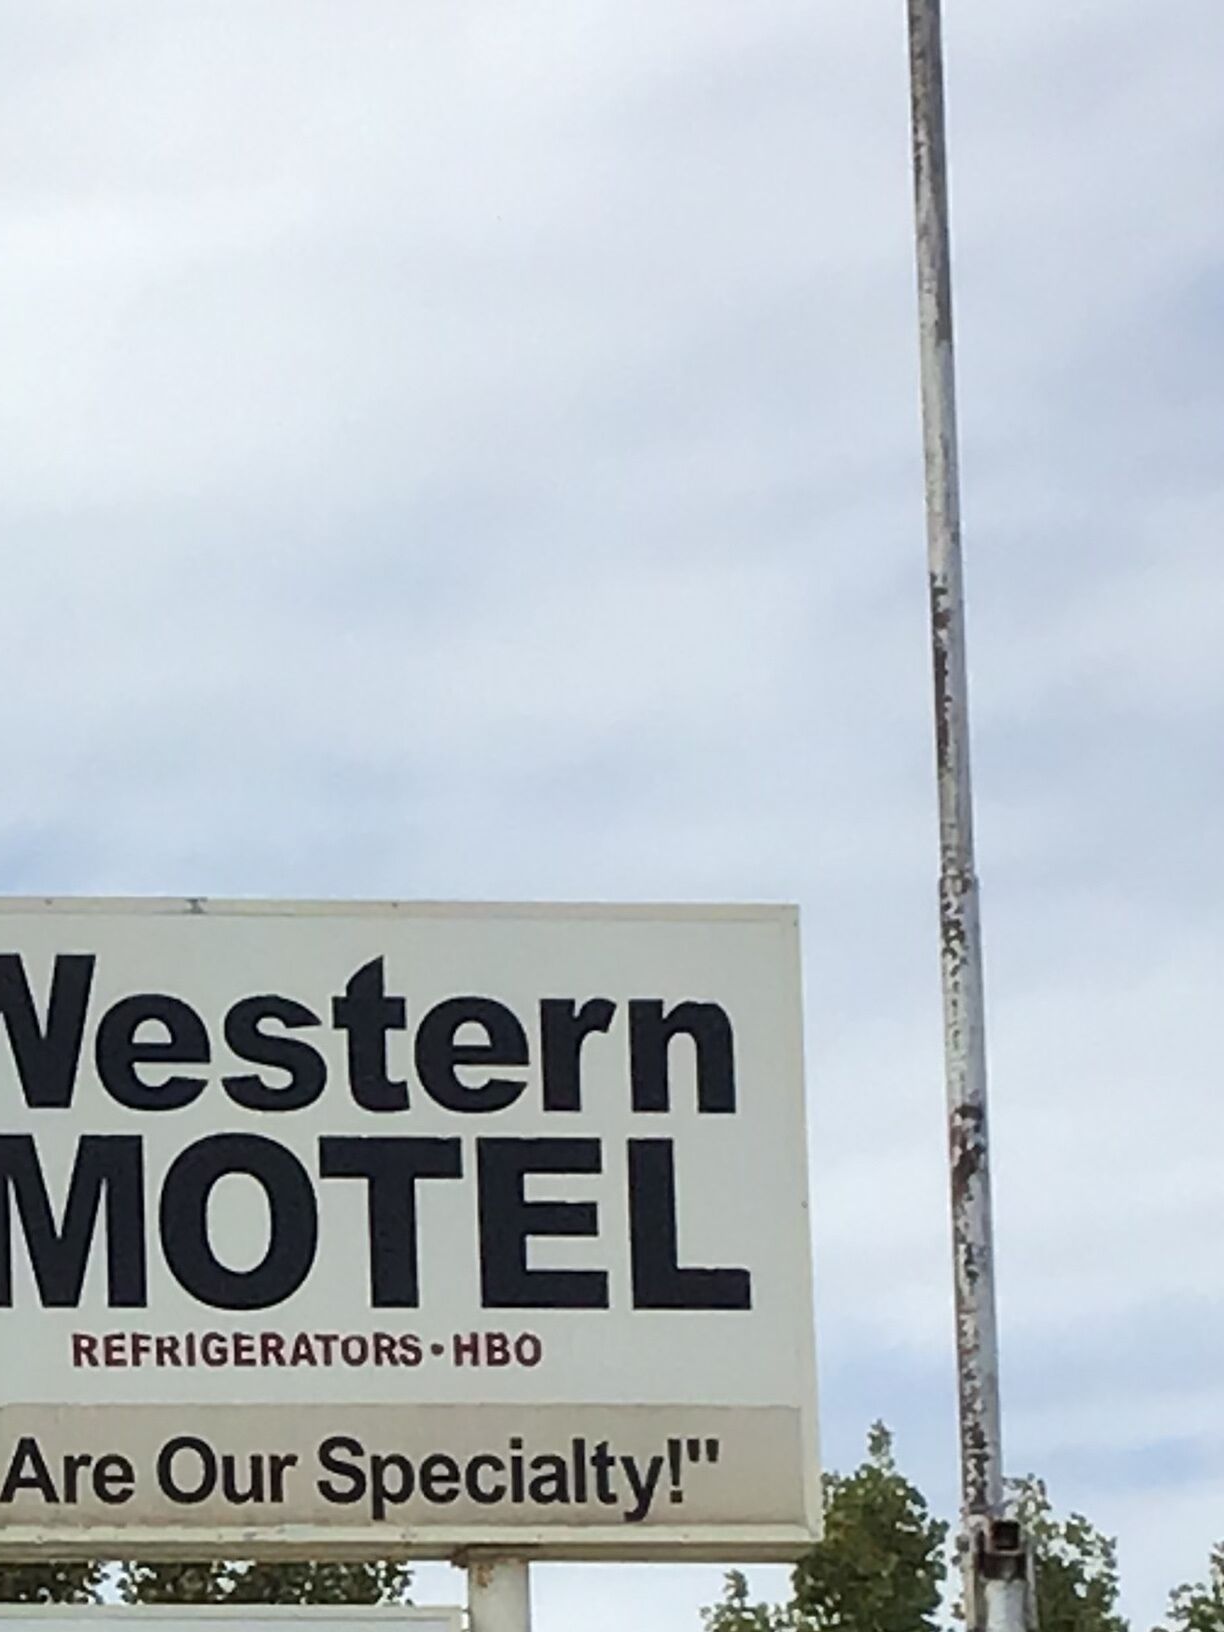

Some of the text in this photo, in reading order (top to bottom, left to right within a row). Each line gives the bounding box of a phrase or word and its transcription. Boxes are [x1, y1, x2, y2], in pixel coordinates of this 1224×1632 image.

[72, 1332, 543, 1368] REFRIGERATORS HBO
[157, 1436, 298, 1504] Our
[317, 1436, 719, 1523] Specialty!"
